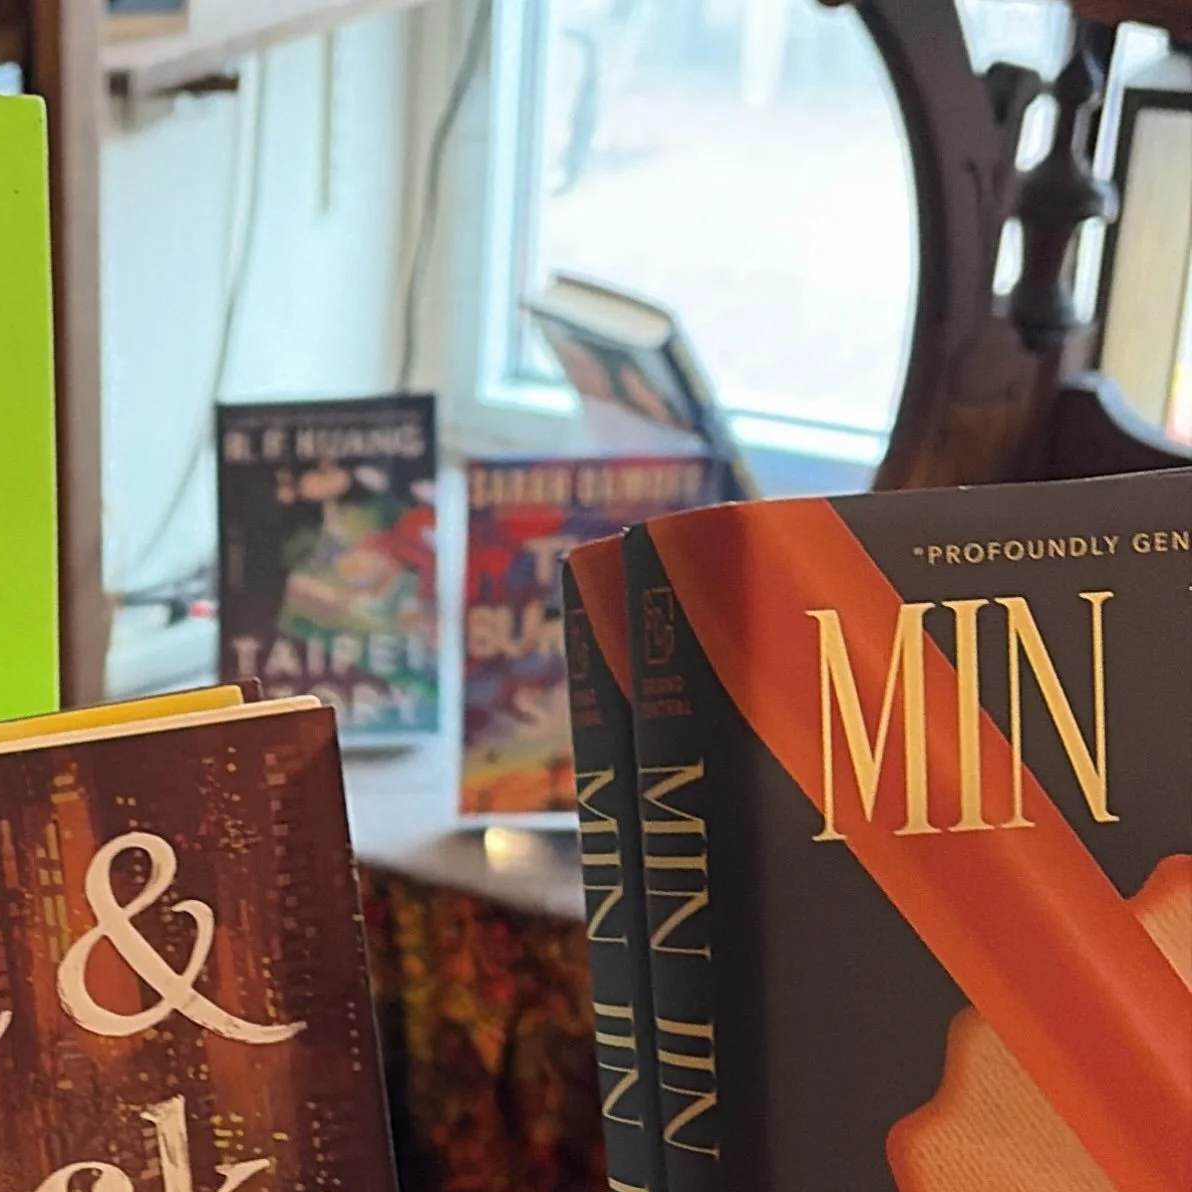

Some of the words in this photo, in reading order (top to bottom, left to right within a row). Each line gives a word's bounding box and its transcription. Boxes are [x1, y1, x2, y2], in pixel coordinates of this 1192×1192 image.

[806, 590, 1120, 842] MIN
[56, 830, 308, 1044] &
[576, 766, 628, 950] MIN
[639, 757, 711, 961] MIN
